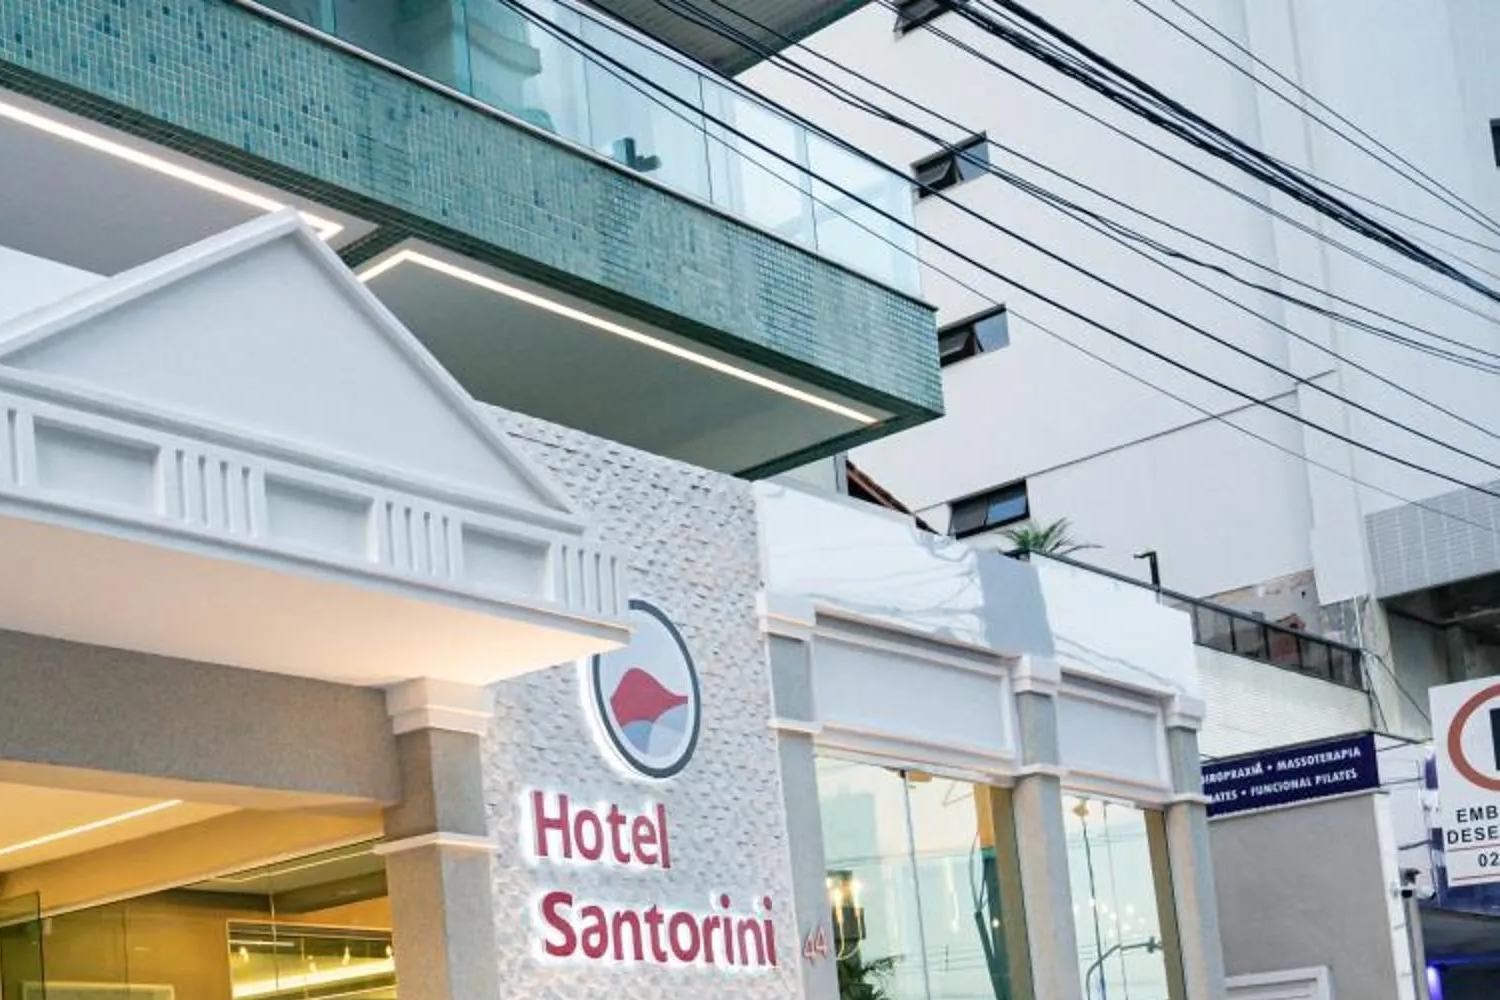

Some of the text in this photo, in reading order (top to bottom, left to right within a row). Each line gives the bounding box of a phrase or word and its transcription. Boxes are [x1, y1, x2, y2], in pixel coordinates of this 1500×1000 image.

[1276, 746, 1361, 770] MASSOTERAPIA
[1251, 777, 1312, 797] FUNCIONAL
[1315, 767, 1358, 786] PILATES
[1456, 805, 1499, 823] EMB
[532, 790, 671, 869] Hotel
[1447, 825, 1499, 845] DESE
[1478, 852, 1500, 868] 02
[542, 891, 780, 967] Santorini
[803, 926, 829, 962] 44
